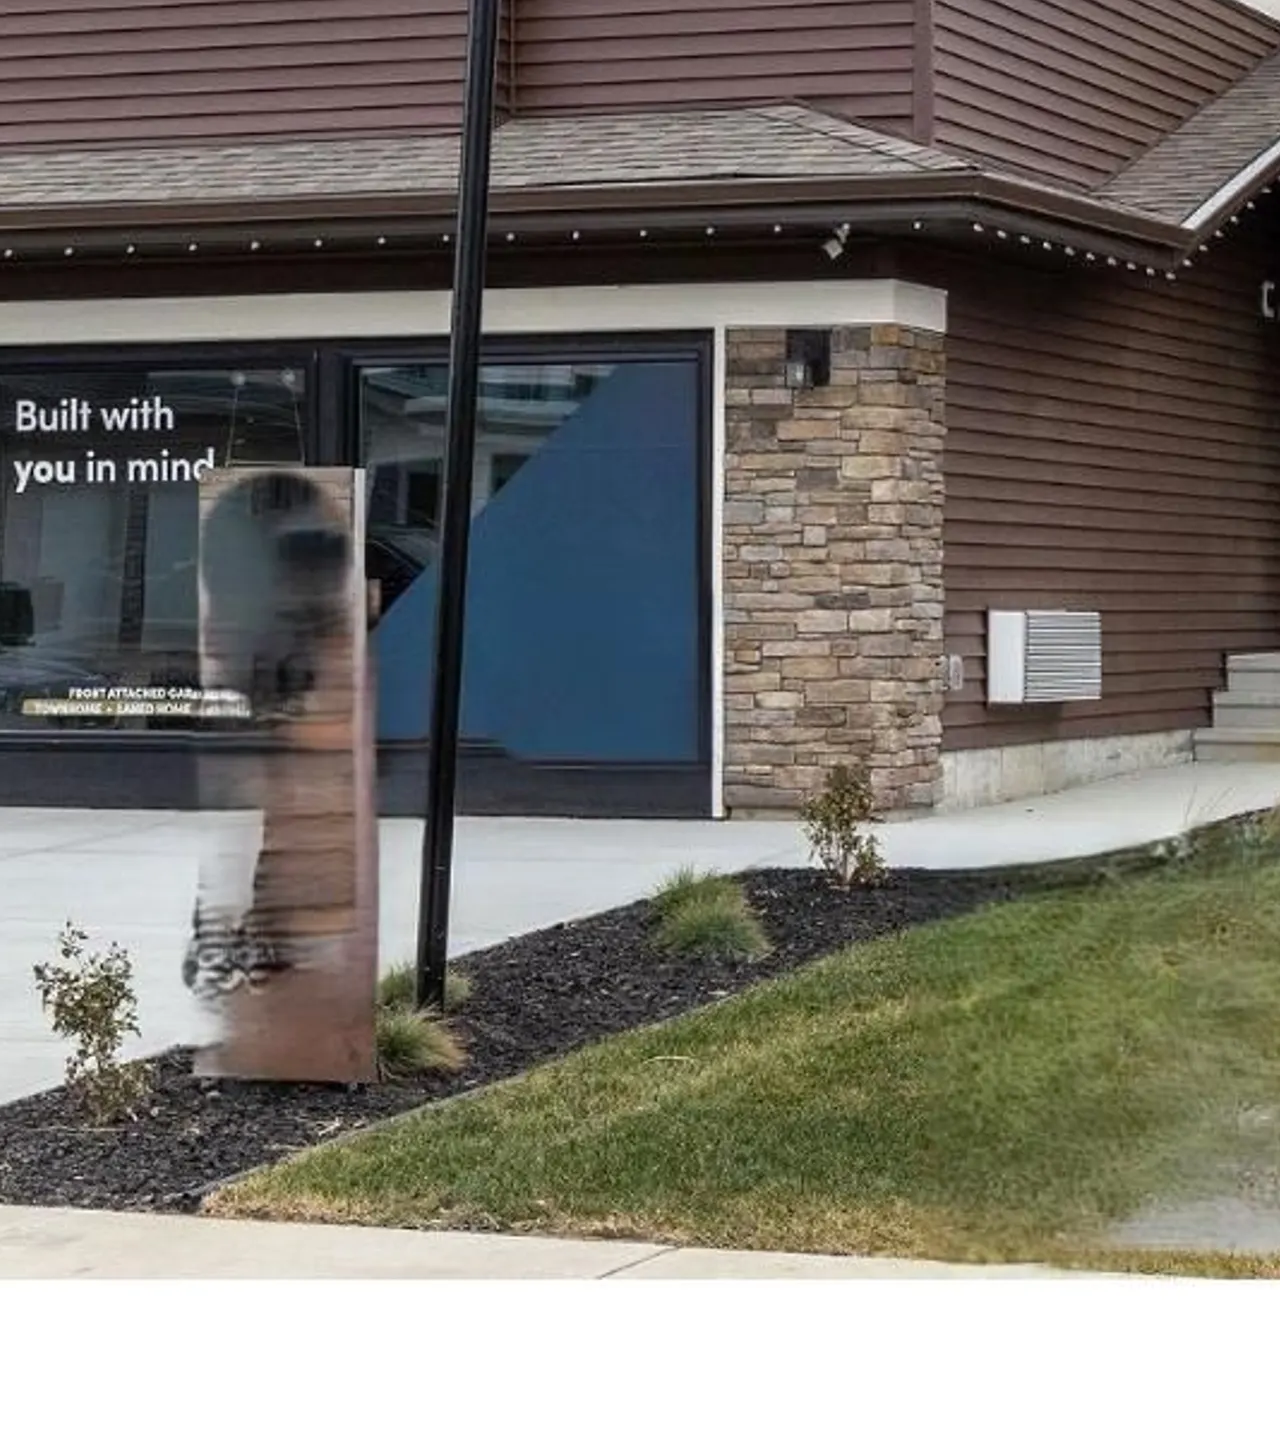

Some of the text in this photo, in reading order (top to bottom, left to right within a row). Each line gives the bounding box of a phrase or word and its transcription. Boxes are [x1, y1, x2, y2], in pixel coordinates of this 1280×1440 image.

[16, 396, 173, 431] Built with
[14, 447, 214, 493] you in mind
[107, 687, 165, 700] ATTACHED
